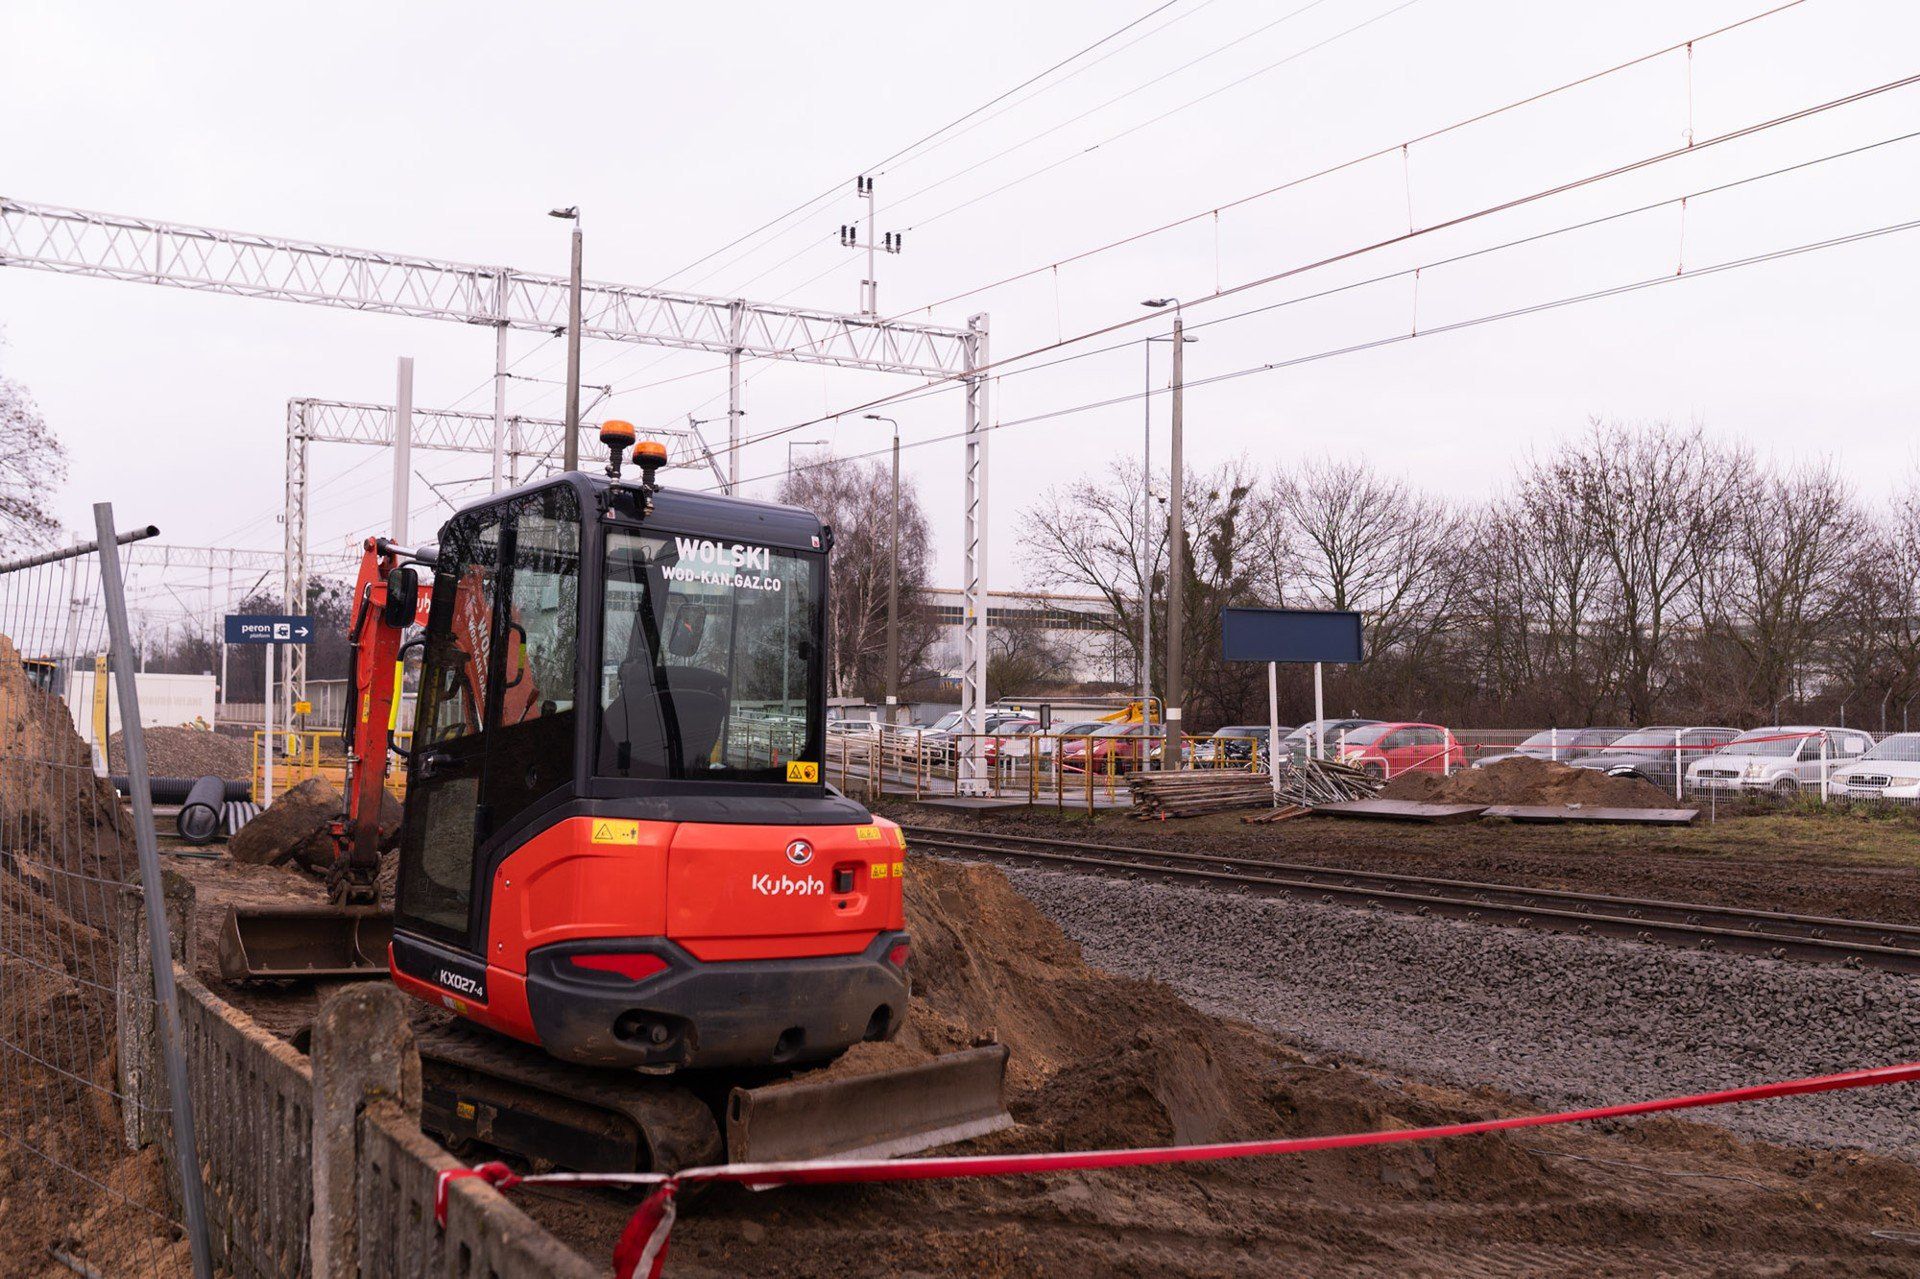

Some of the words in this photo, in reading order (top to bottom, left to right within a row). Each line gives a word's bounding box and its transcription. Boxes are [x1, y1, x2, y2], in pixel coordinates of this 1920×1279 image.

[675, 536, 770, 571] WOLSKI
[661, 565, 781, 592] WOD-KAN.GAZ.CO
[241, 624, 271, 634] peron
[752, 874, 825, 896] Kubota
[440, 969, 483, 997] KX027-4
